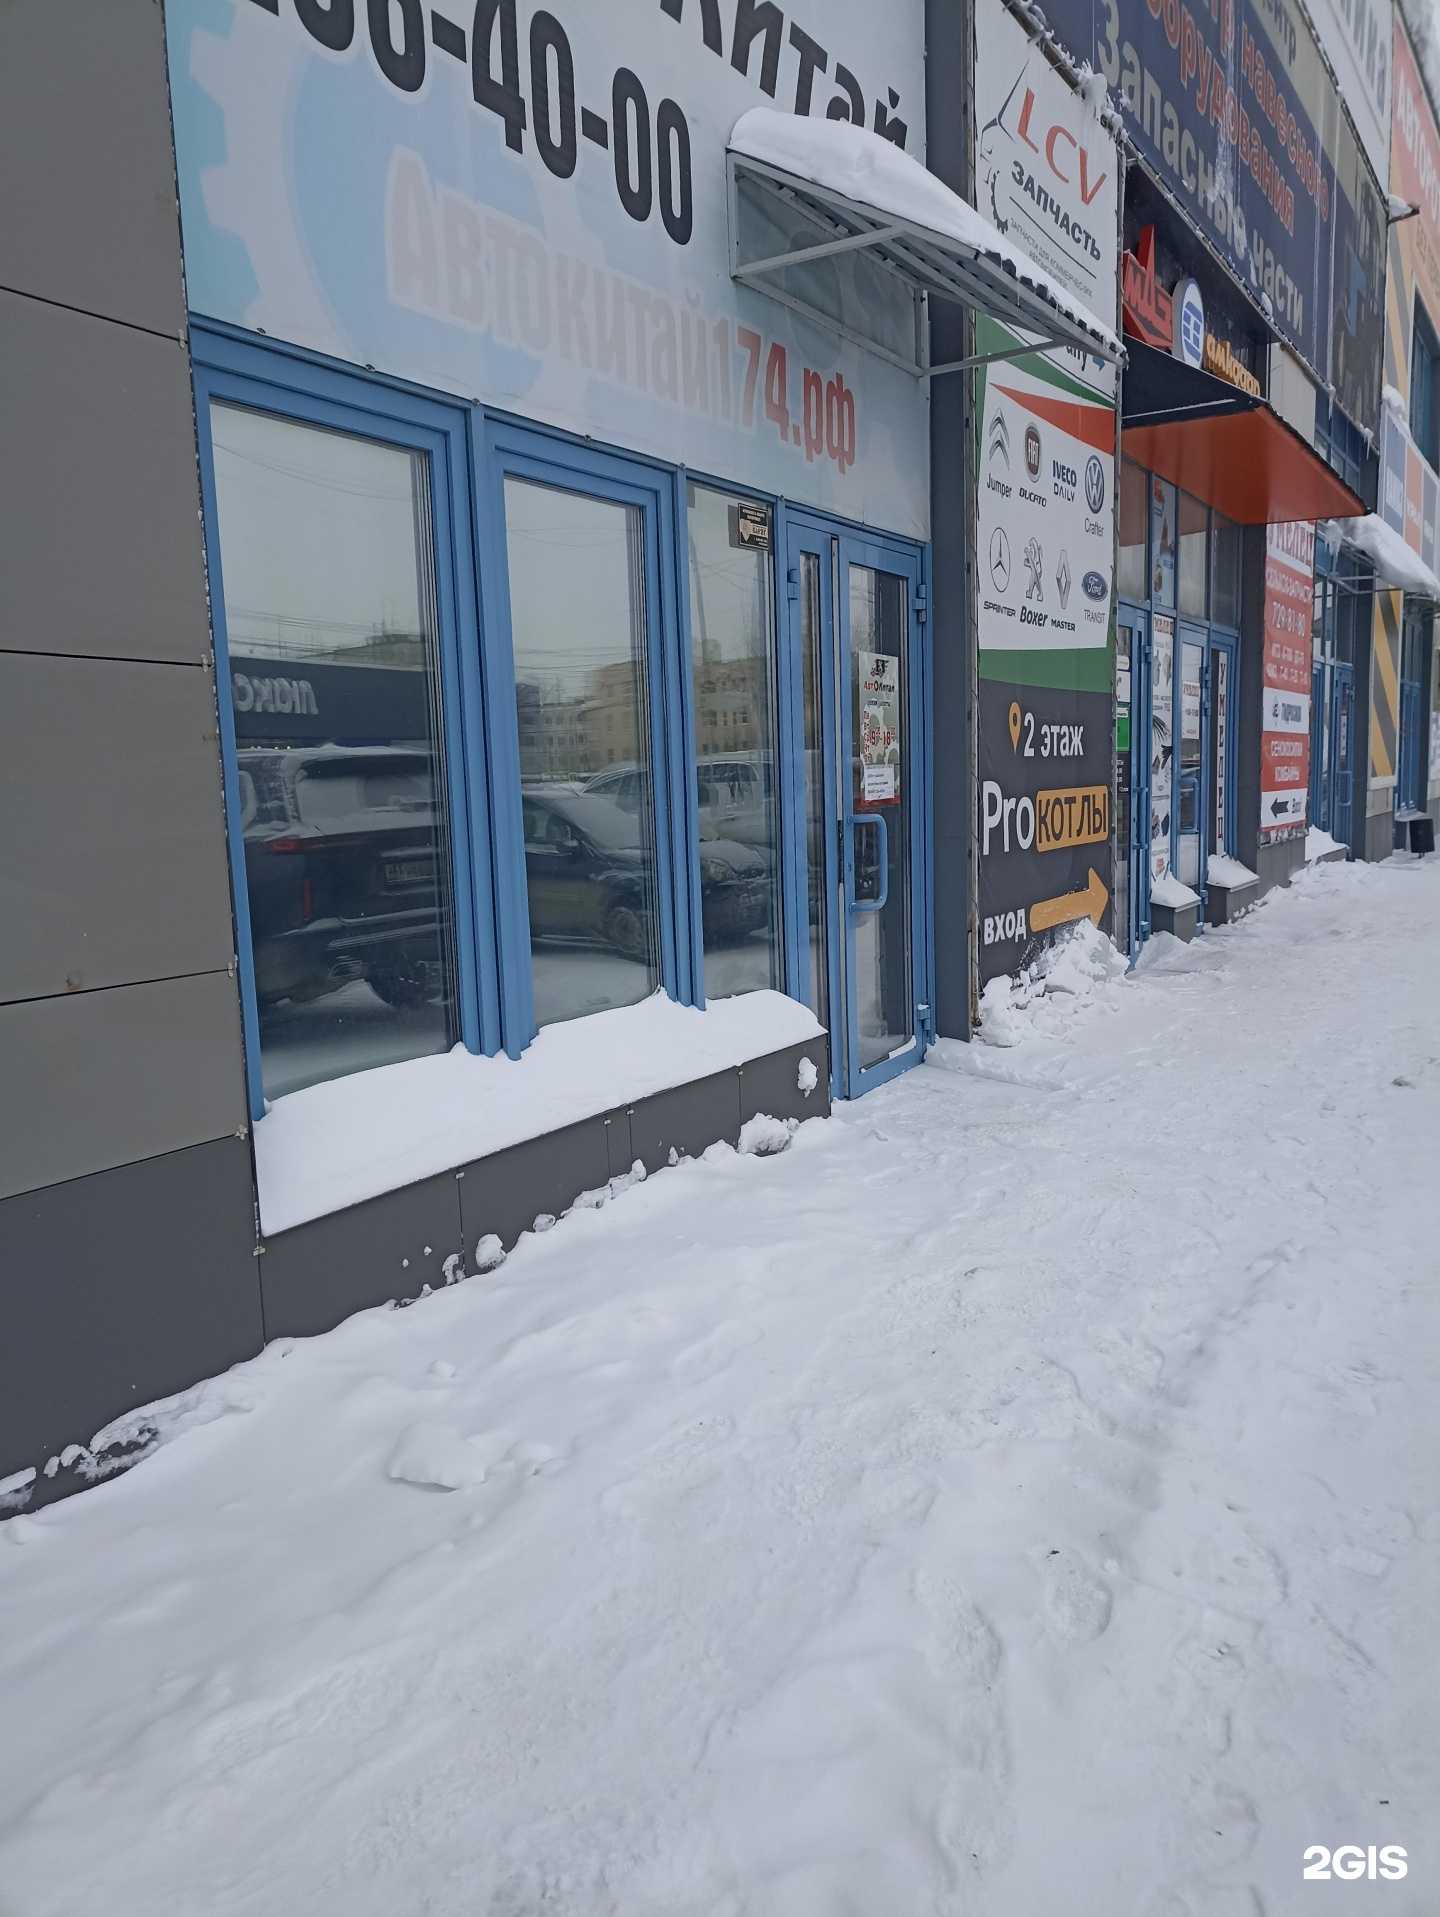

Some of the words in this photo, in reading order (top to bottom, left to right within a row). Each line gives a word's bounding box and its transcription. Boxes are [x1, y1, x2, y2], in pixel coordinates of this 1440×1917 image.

[659, 0, 907, 151] итай
[1240, 20, 1329, 223] навесного
[1017, 87, 1107, 206] LCV
[1011, 160, 1101, 261] ЗАПЧАСТЬ
[1253, 228, 1303, 337] части
[986, 473, 1013, 499] Jumper
[1052, 459, 1078, 488] IVECO
[1019, 487, 1048, 508] DUCATO
[1053, 482, 1076, 503] DAILY
[1084, 517, 1105, 537] Crafter
[983, 600, 1017, 617] SPRINTER
[1019, 605, 1050, 628] Boxer
[1050, 618, 1076, 632] MASTER
[1023, 711, 1036, 757] 2
[1041, 724, 1085, 757] этаж
